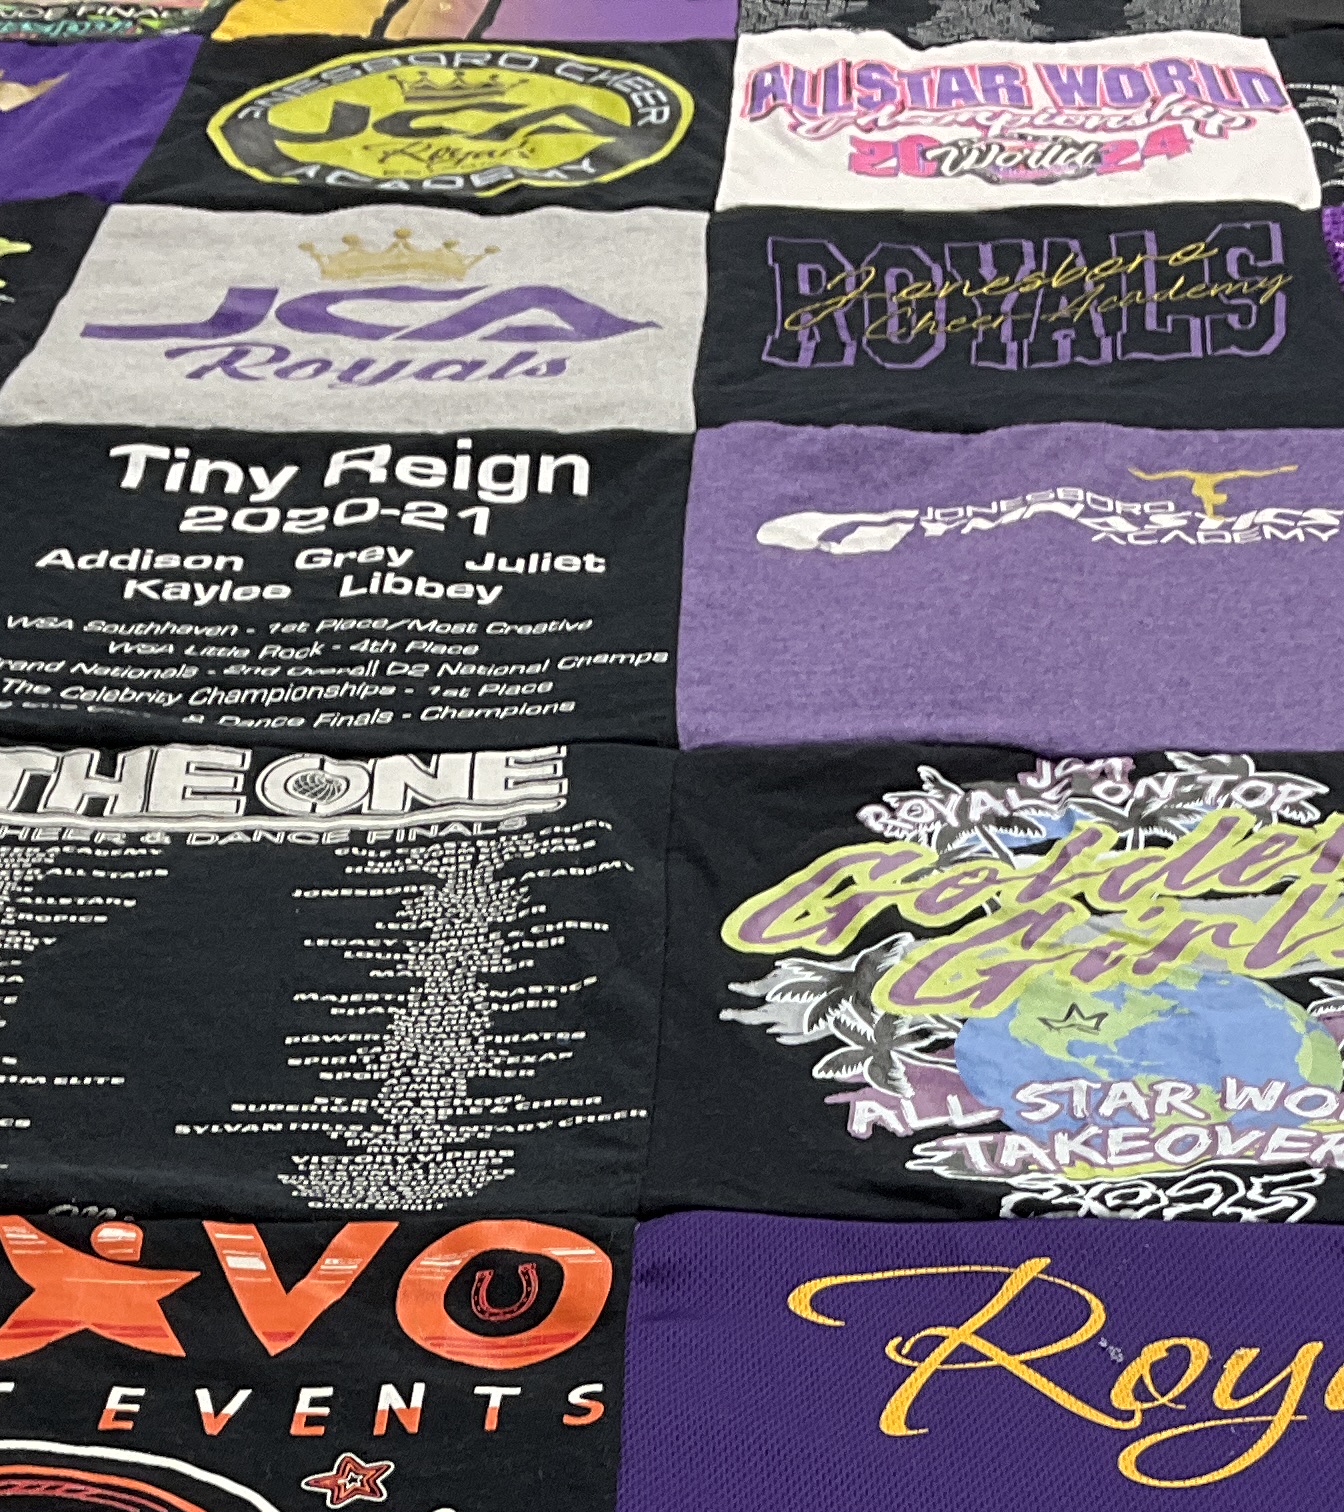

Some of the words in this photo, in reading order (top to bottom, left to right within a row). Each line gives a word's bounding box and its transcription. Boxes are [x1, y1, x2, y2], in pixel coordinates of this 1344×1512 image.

[1033, 56, 1296, 113] WORLD
[761, 220, 1288, 371] ROYALS
[784, 240, 1223, 332] Jonesboro
[864, 303, 1024, 342] Cheer
[1054, 268, 1296, 322] Academy
[78, 285, 666, 342] JCA
[164, 342, 576, 390] Royals
[109, 443, 299, 503] Tiny
[324, 438, 590, 503] Reign
[178, 497, 492, 537] 2020-21
[1091, 527, 1342, 546] ACADEMY
[35, 548, 244, 572] Addison
[295, 545, 414, 570] Grey
[464, 552, 607, 575] Juliet
[339, 571, 504, 605] Libbey
[7, 615, 74, 631] WSA
[268, 621, 310, 635] 1st
[486, 618, 594, 635] Creative
[108, 641, 175, 656] WSA
[184, 645, 251, 659] Little
[258, 641, 323, 660] Rock
[349, 638, 398, 655] 4th
[404, 640, 480, 656] Place
[70, 661, 200, 680] Nationals
[385, 660, 431, 678] D2
[437, 658, 551, 678] National
[558, 649, 669, 672] Champs
[2, 677, 52, 695] The
[60, 683, 183, 708] Celebrity
[188, 681, 397, 707] Championships
[477, 680, 554, 697] Place
[313, 702, 394, 729] Finals
[420, 700, 576, 723] Champions
[256, 745, 569, 817] ONE
[858, 772, 1067, 837] ROYALS
[1191, 772, 1321, 822] TOP
[185, 826, 351, 847] DANCE
[366, 816, 529, 846] FINALS
[847, 1092, 1003, 1138] ALL
[1012, 1076, 1216, 1122] STAR
[96, 1381, 609, 1440] EVENTS
